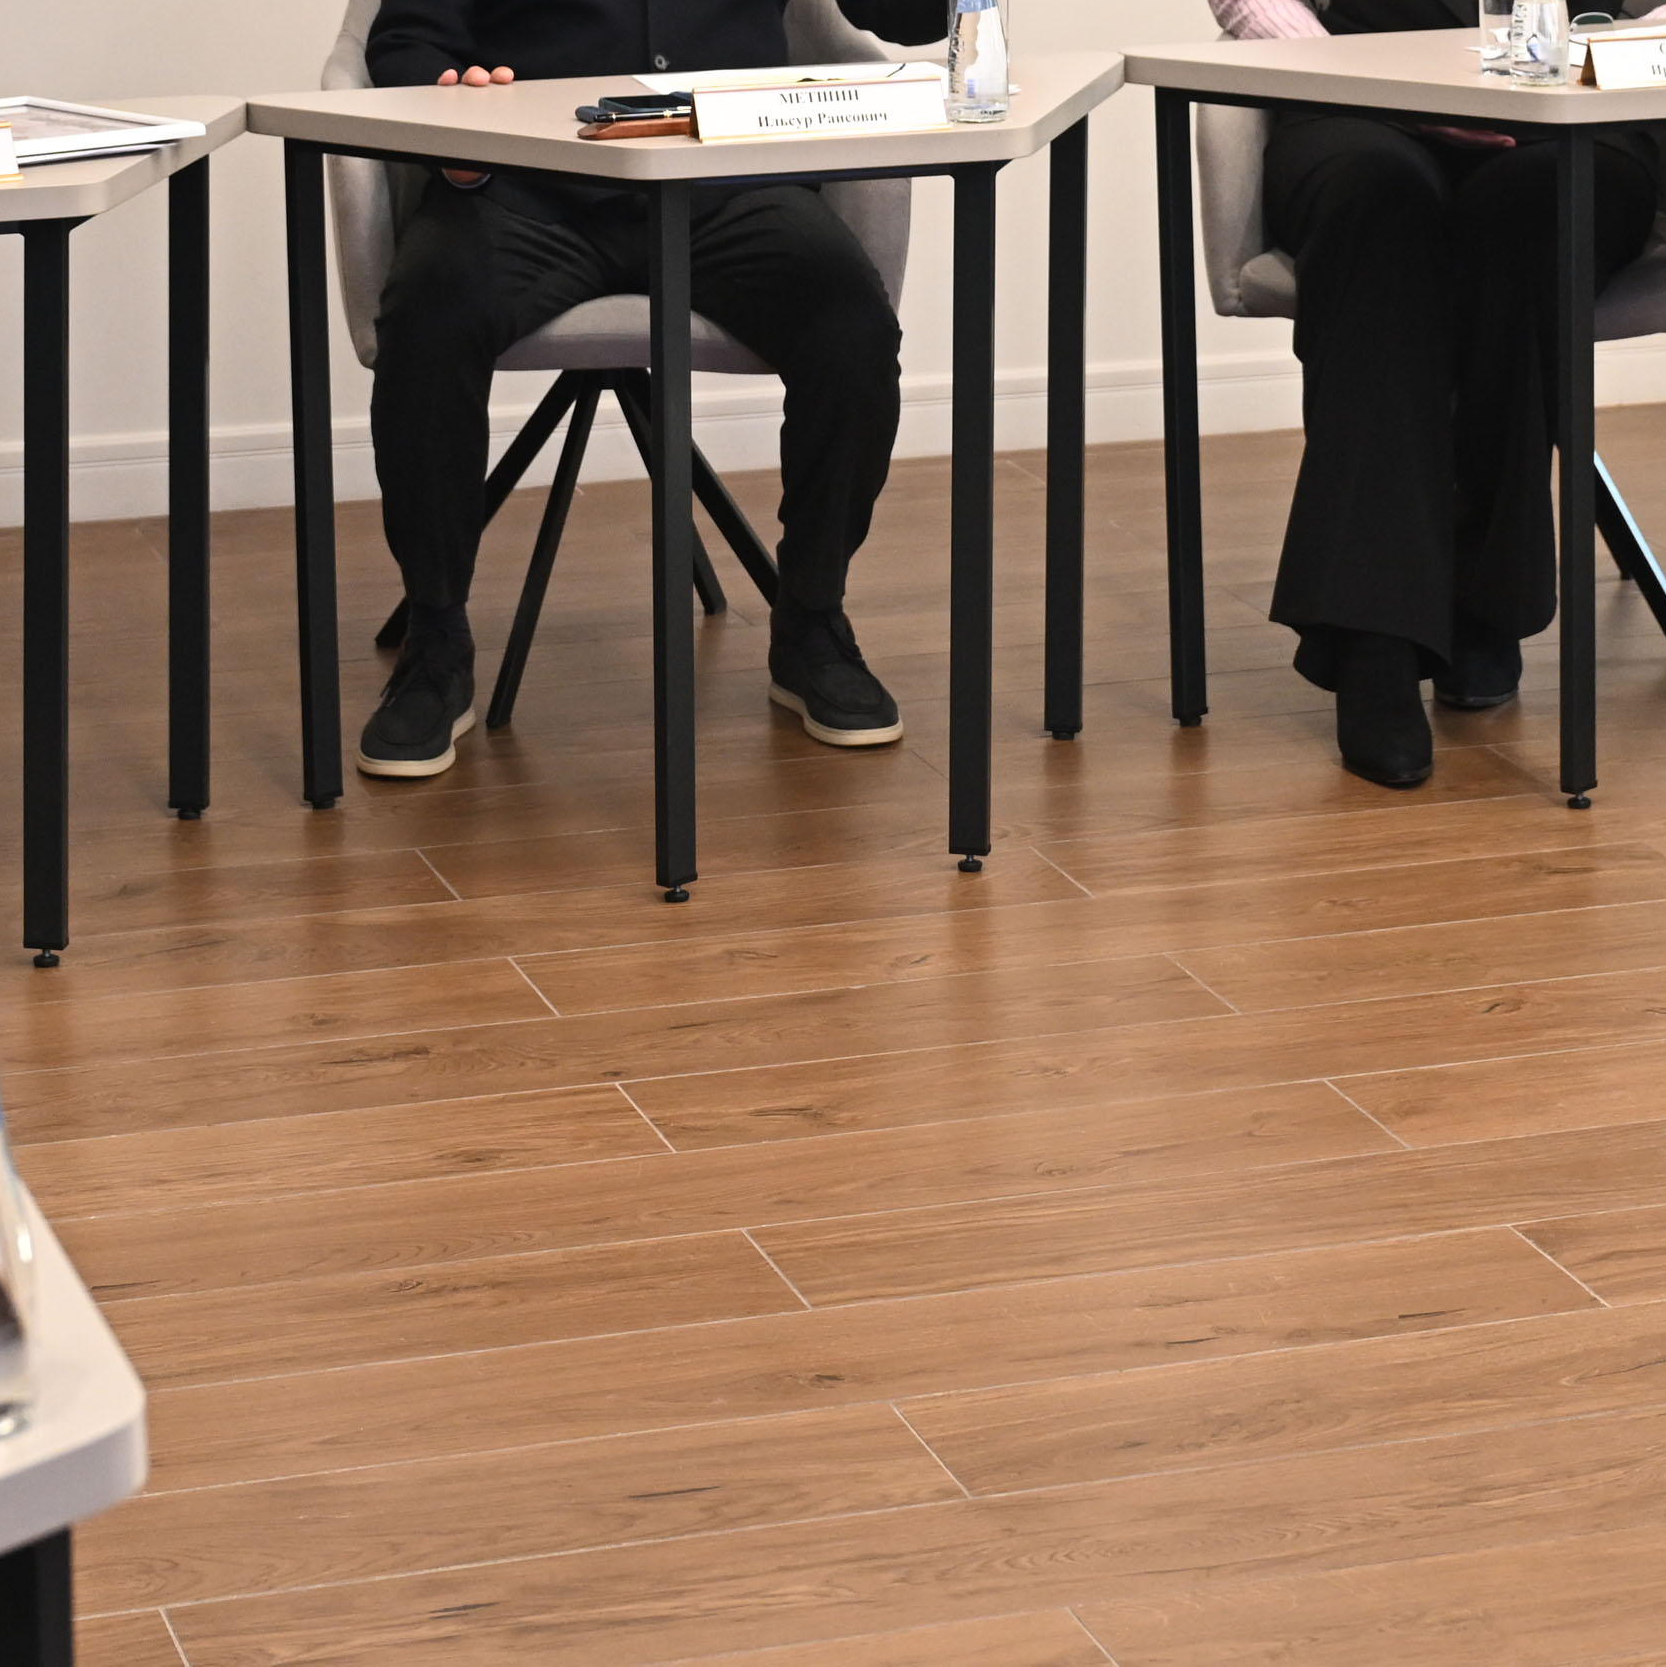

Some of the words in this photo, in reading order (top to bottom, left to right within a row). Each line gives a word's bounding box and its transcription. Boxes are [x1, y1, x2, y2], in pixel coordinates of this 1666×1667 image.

[779, 89, 859, 104] МЕТШИН
[757, 115, 813, 129] Ильсур
[817, 112, 888, 124] Раисович
